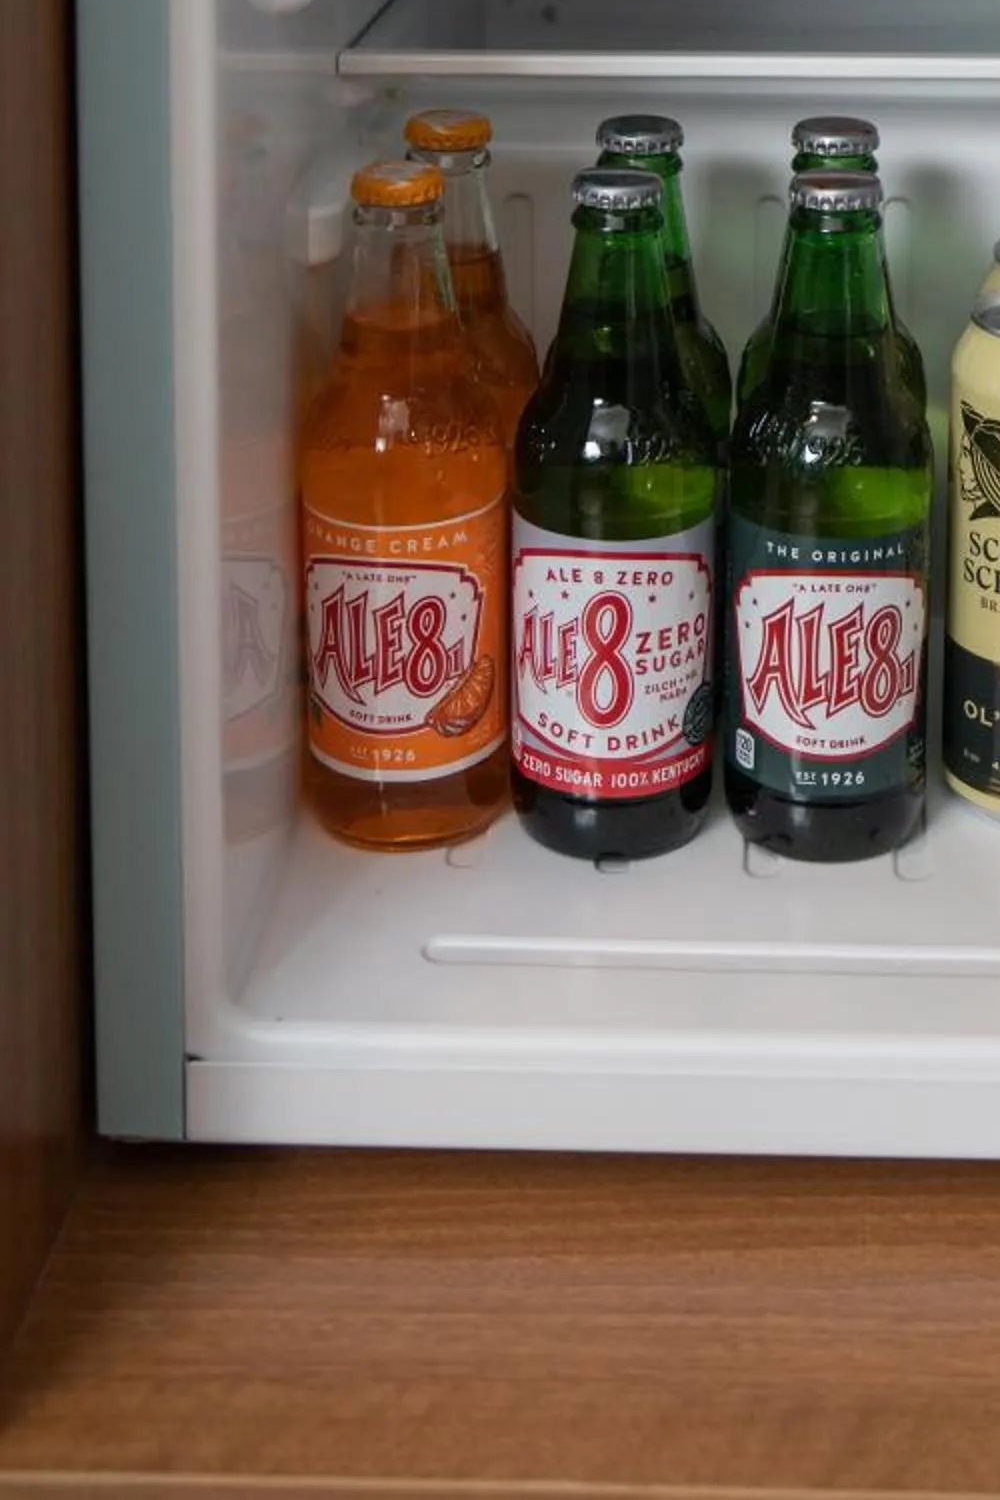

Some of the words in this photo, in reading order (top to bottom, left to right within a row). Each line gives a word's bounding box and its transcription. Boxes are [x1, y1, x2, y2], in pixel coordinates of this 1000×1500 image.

[389, 529, 469, 554] CREAM
[767, 541, 800, 559] THE
[811, 544, 905, 563] ORIGINAL
[545, 567, 583, 584] ALE
[593, 570, 604, 585] 8
[616, 571, 674, 585] ZERO
[635, 612, 705, 655] ZERO
[635, 640, 706, 676] SUGAR
[537, 712, 595, 749] SOFT
[607, 716, 681, 752] DRINK
[522, 752, 551, 777] ZERO
[555, 766, 604, 788] SUGAR
[610, 769, 649, 789] 100%
[821, 770, 865, 787] 1926
